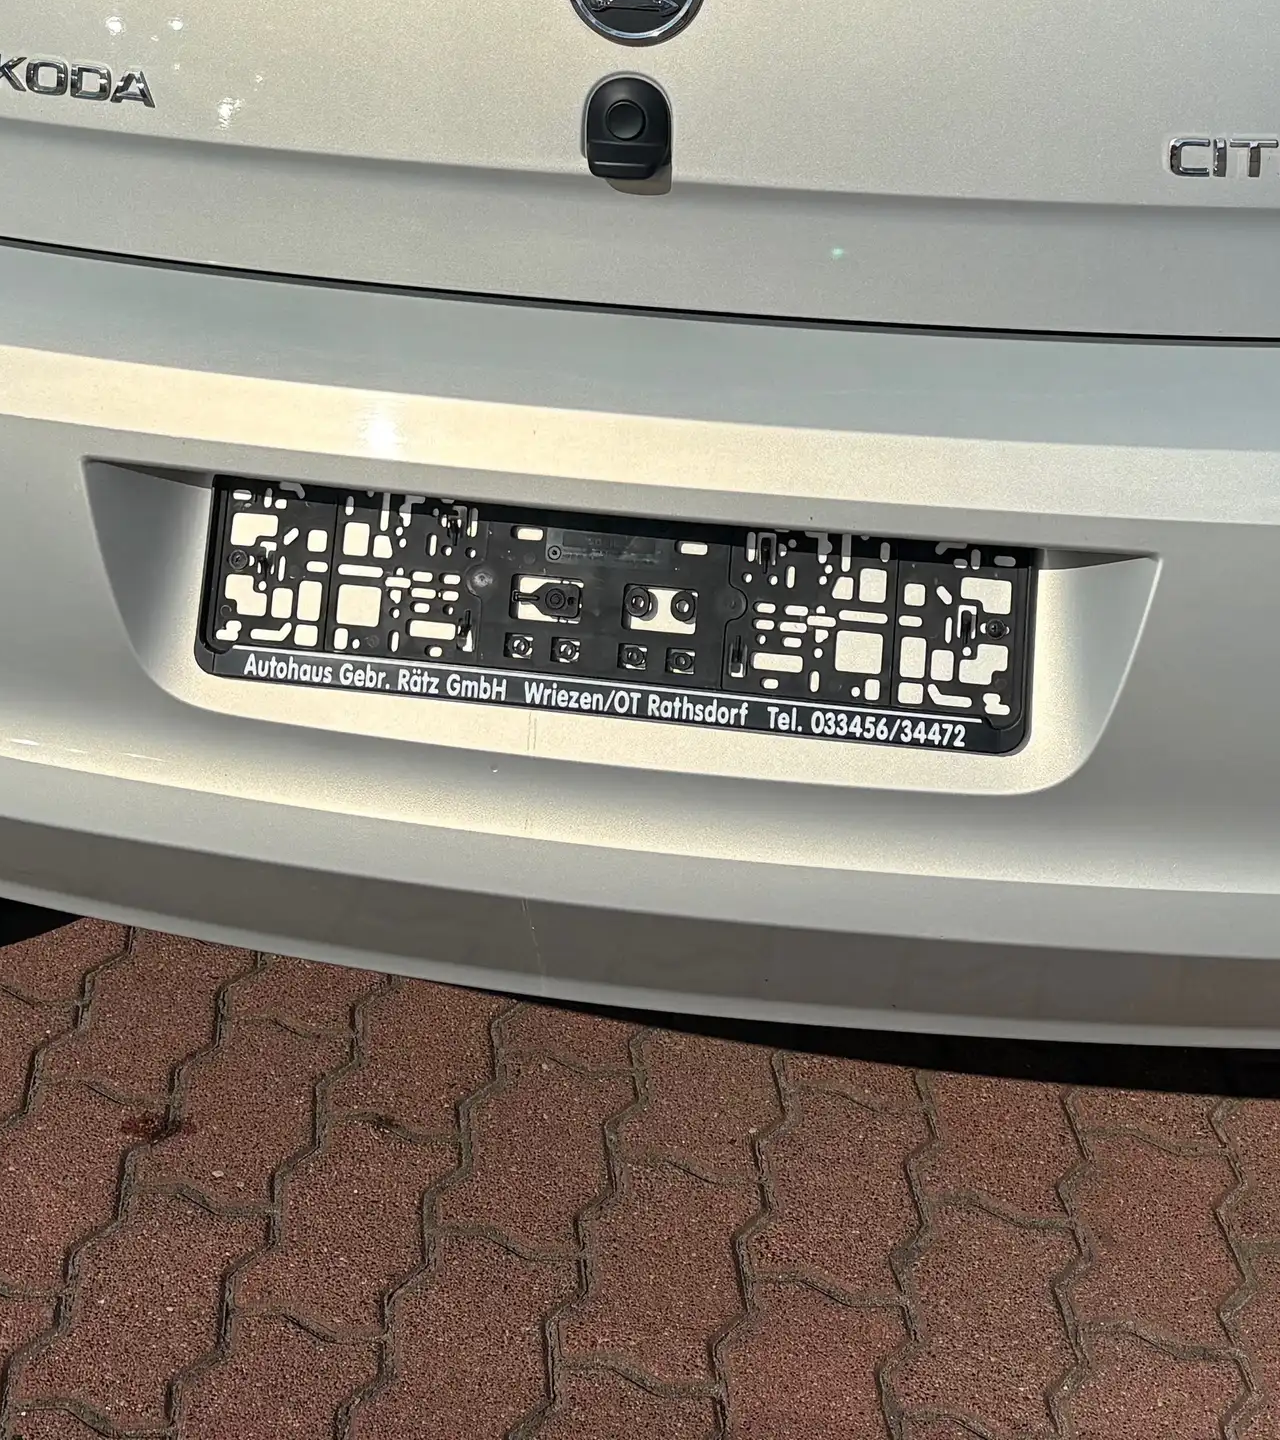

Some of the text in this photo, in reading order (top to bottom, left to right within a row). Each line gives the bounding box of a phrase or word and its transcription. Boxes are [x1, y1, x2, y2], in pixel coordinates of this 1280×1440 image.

[243, 653, 966, 747] Autohaus Gebr. Rätz GmbH Wriezen/OT Rathsdorf Tel. 033456/34472
